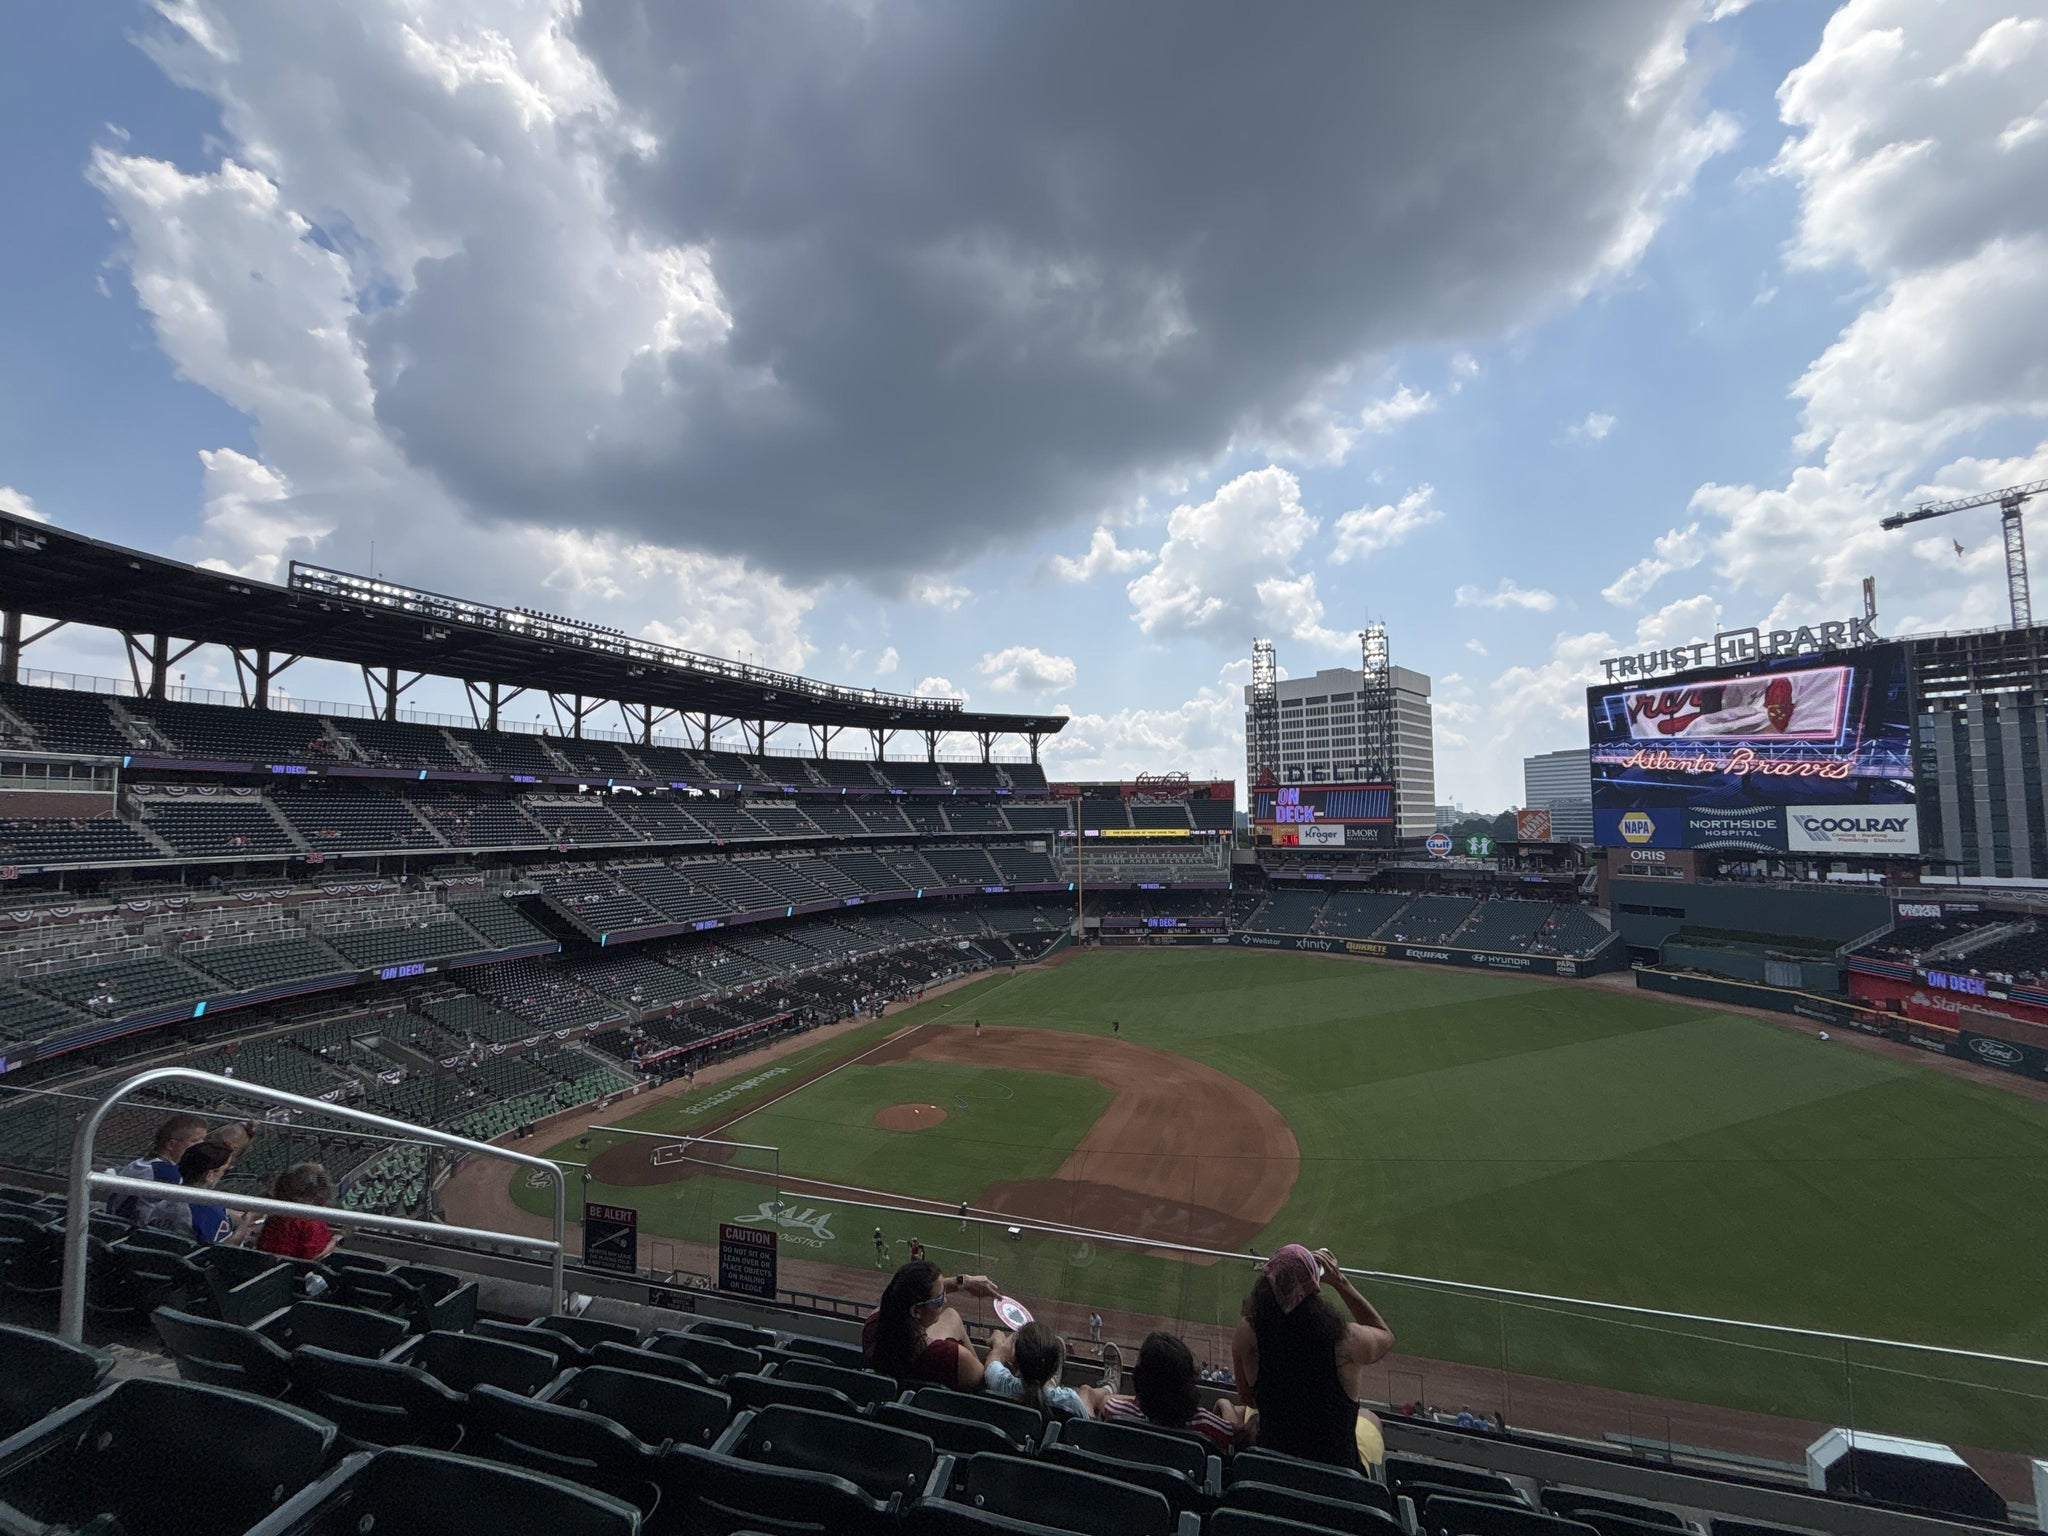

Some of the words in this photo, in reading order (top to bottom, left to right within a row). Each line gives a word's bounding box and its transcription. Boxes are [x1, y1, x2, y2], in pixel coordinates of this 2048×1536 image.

[1600, 642, 1708, 679] TRUIST
[1769, 613, 1879, 651] PARK
[272, 764, 285, 774] ON
[1622, 748, 1716, 772] Atlanta
[1723, 747, 1851, 779] Braves
[1287, 762, 1386, 782] DELTA
[1277, 787, 1300, 805] ON
[1275, 805, 1317, 823] DECK
[1518, 810, 1551, 839] HOME
[1624, 821, 1650, 835] NAPA
[1689, 819, 1777, 829] NORTHSIDE
[1804, 817, 1910, 833] COOLRAY
[1305, 826, 1337, 844] Kroger
[1346, 829, 1379, 837] EMORY
[1427, 839, 1451, 849] Gulf
[1630, 850, 1666, 861] ORIS
[1898, 904, 1940, 912] BRAVES
[1899, 910, 1941, 918] VISION
[1147, 918, 1158, 927] ON
[1159, 918, 1177, 927] DECK
[1251, 937, 1281, 946] Wellstar
[1295, 937, 1332, 951] xfinity
[1345, 941, 1388, 953] QUIKRETE
[1406, 949, 1449, 961] EQUIFAX
[1488, 956, 1530, 966] HYUNDAI
[1556, 960, 1576, 968] PAPA
[381, 966, 397, 980] ON
[398, 963, 425, 977] DECK
[1927, 971, 1947, 989] ON
[1949, 975, 1987, 997] DECK
[1978, 1041, 2013, 1059] Ford
[589, 1205, 602, 1218] BE
[603, 1208, 633, 1222] ALERT
[734, 1201, 836, 1240] SAIA
[725, 1227, 770, 1245] CAUTION
[775, 1231, 825, 1248] OGISTICS
[722, 1245, 732, 1253] DO
[733, 1247, 747, 1255] NOT
[723, 1254, 740, 1263] LEAN
[741, 1257, 759, 1266] OVER
[760, 1260, 770, 1268] OR
[722, 1262, 742, 1272] PLACE
[743, 1266, 772, 1277] OBJECTS
[728, 1272, 738, 1280] ON
[739, 1274, 765, 1285] RAILING
[730, 1281, 740, 1289] OR
[741, 1283, 762, 1293] LEDGE
